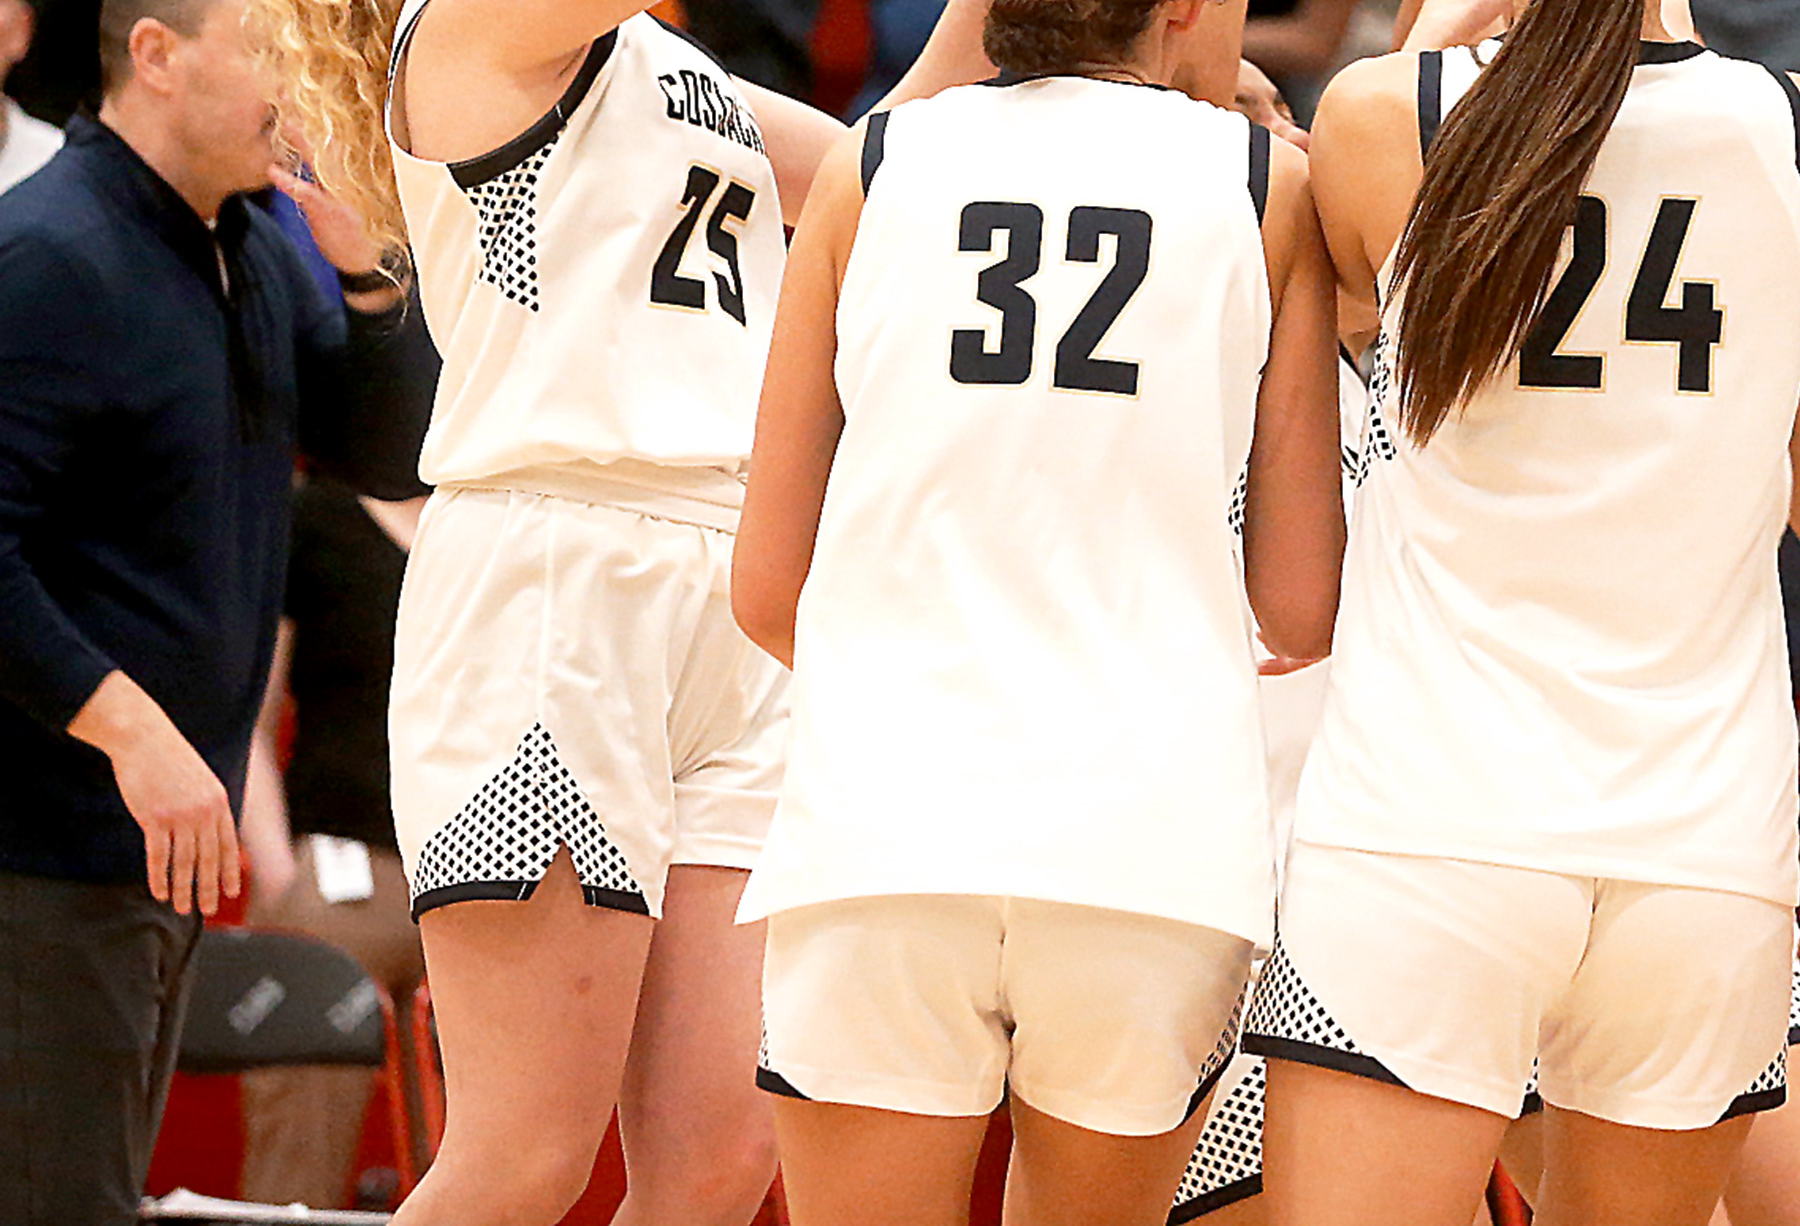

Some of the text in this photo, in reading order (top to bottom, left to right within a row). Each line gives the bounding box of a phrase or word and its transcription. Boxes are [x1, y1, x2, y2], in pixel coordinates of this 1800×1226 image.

[649, 160, 757, 328] 25
[948, 198, 1154, 400] 32
[1514, 191, 1727, 397] 24
